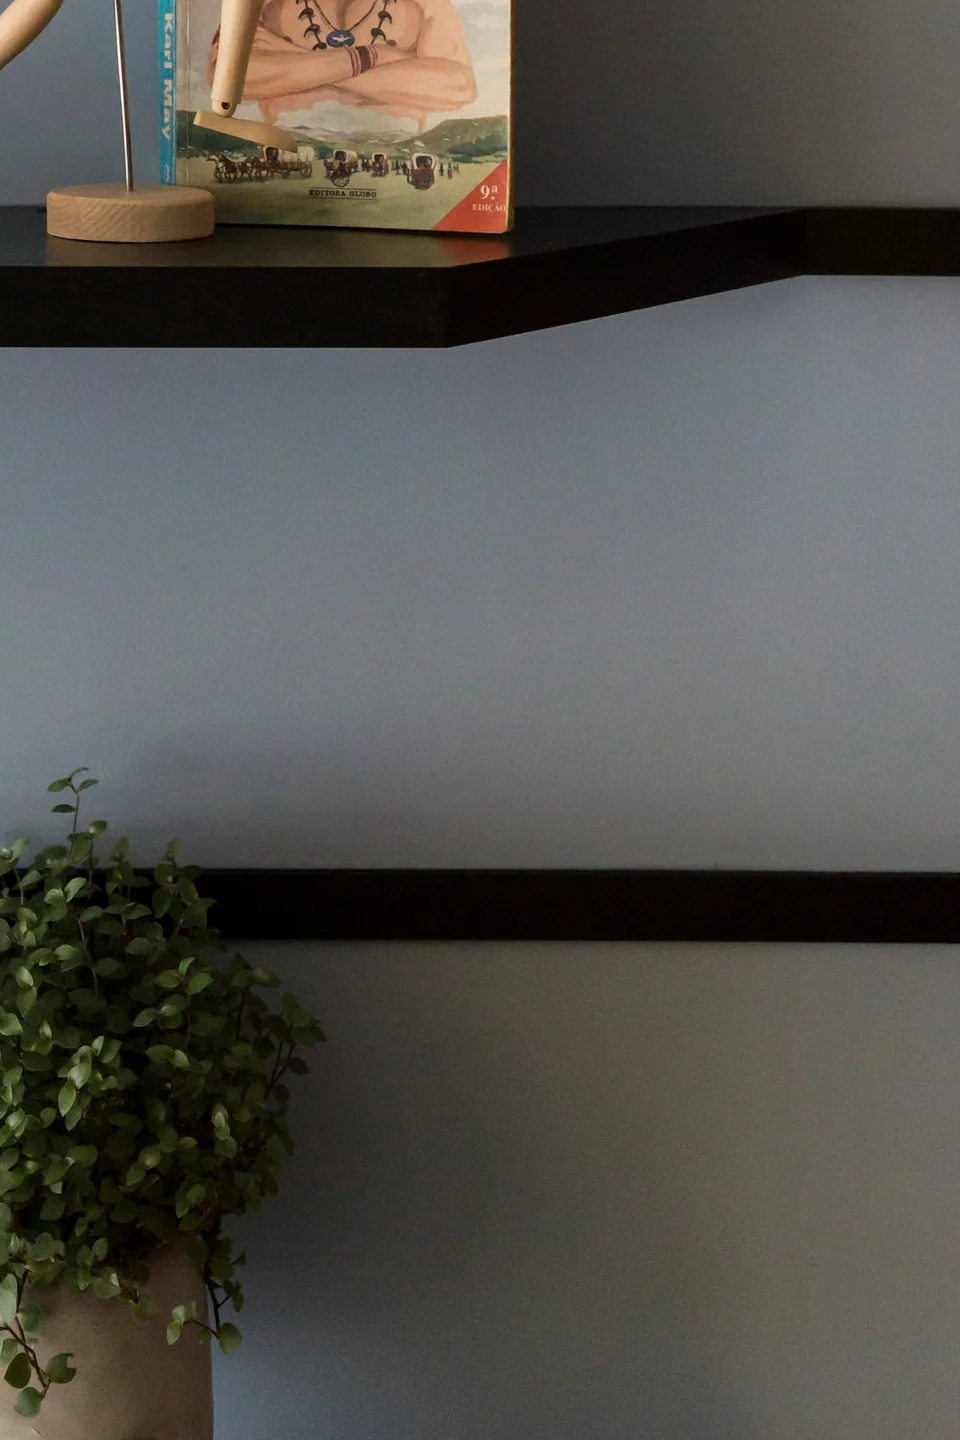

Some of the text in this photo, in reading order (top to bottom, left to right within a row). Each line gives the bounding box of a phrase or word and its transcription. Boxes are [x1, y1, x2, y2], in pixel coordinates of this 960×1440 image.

[162, 13, 173, 141] Karl May
[308, 189, 377, 198] EDITORA GLOBO
[472, 202, 506, 213] EDIÇÃO
